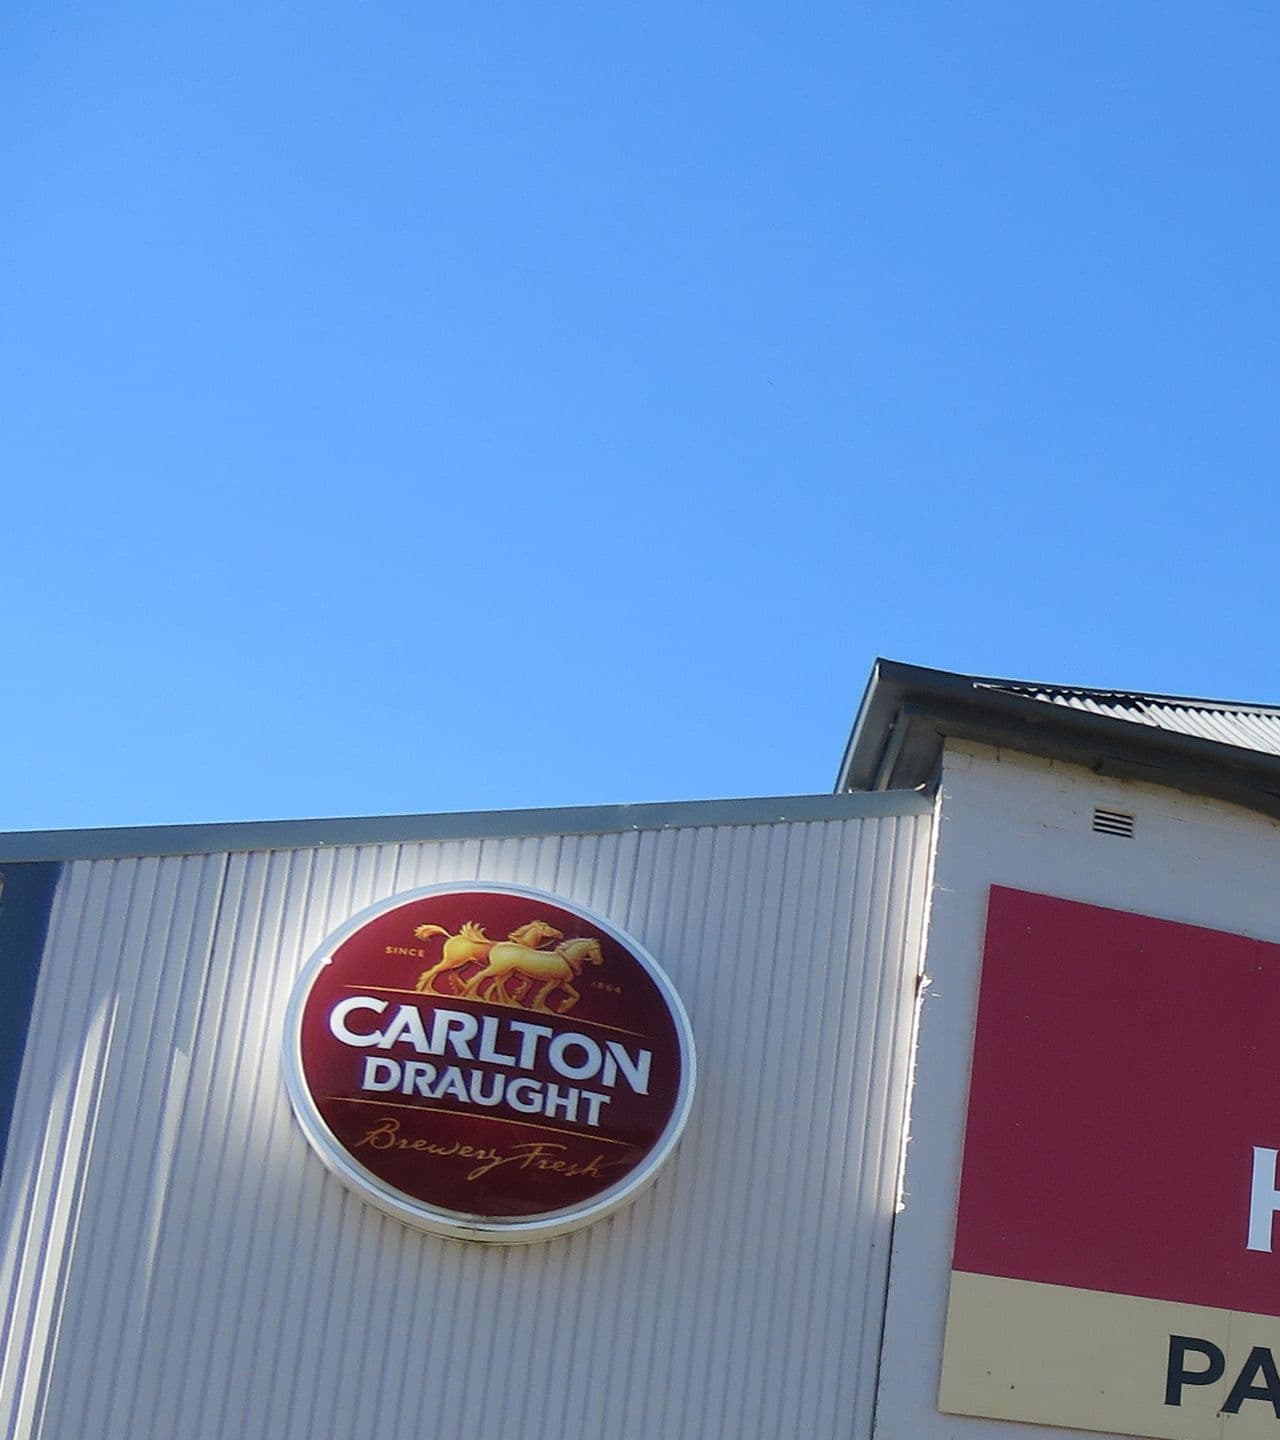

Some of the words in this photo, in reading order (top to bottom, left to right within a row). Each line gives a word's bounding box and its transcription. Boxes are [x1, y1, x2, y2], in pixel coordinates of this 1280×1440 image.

[385, 946, 425, 958] SINCE
[329, 996, 652, 1095] CARLTON
[362, 1056, 611, 1127] DRAUGHT
[353, 1117, 502, 1181] Brewery
[512, 1142, 605, 1178] Fresh
